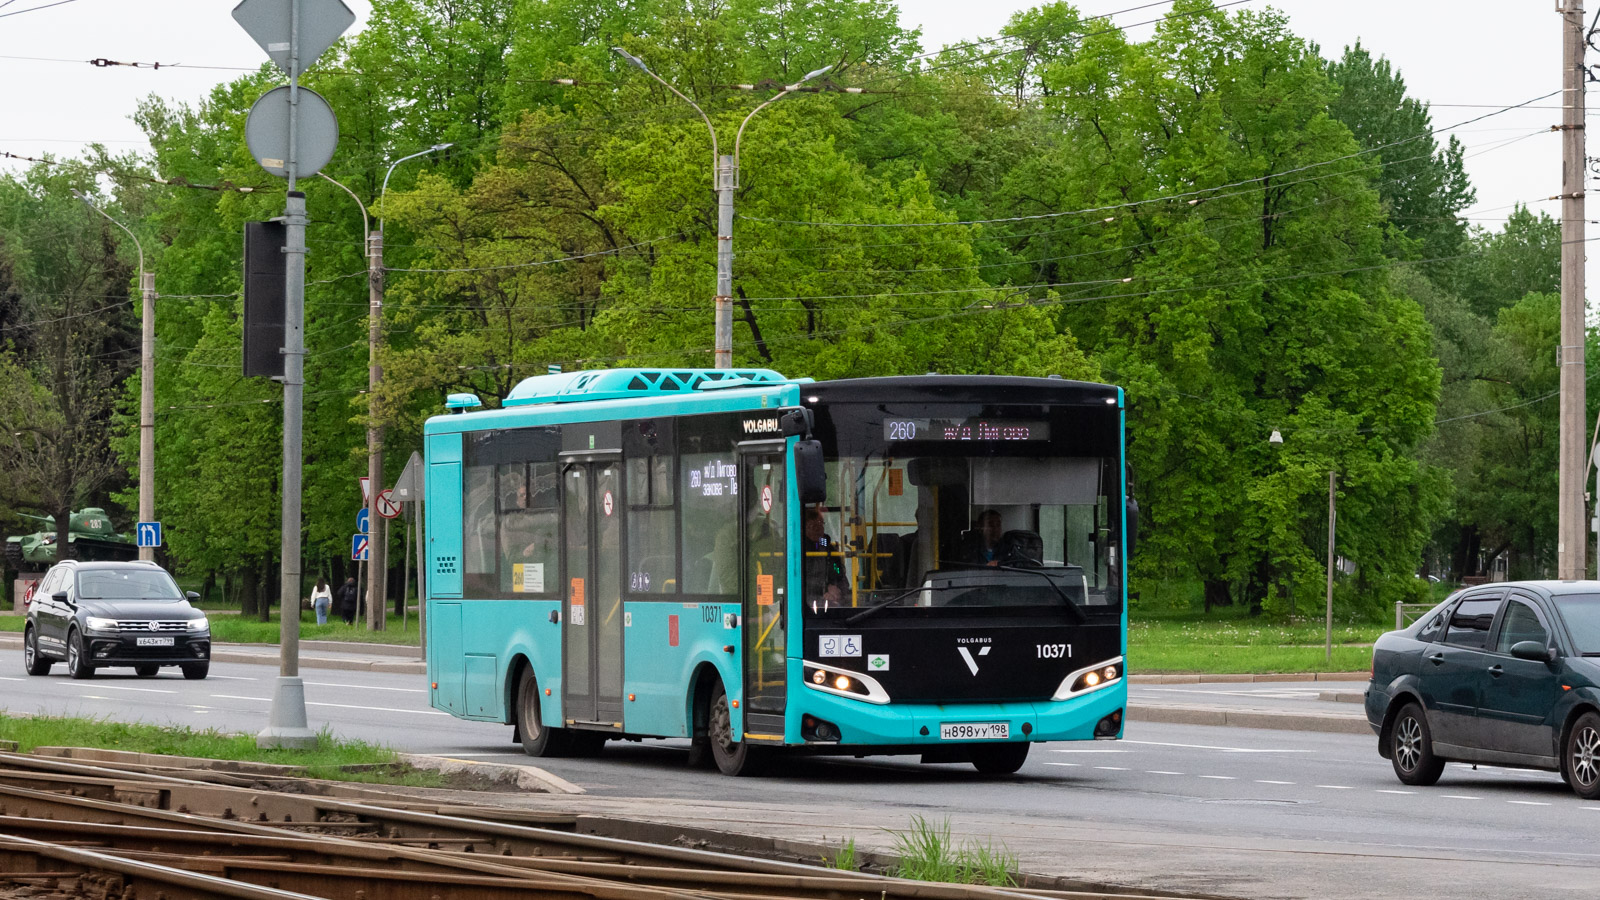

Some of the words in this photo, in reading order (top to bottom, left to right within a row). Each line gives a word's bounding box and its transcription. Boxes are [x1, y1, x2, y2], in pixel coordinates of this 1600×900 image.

[743, 418, 782, 433] VOLGABU
[889, 421, 916, 440] 260
[978, 421, 1029, 440] Лигово
[704, 460, 715, 478] ж/д
[716, 460, 737, 478] Лигово
[690, 470, 701, 487] 260
[702, 483, 722, 496] закова
[90, 519, 102, 529] 283
[701, 605, 722, 623] 10371
[1036, 644, 1072, 658] 10371
[989, 724, 1006, 734] 198
